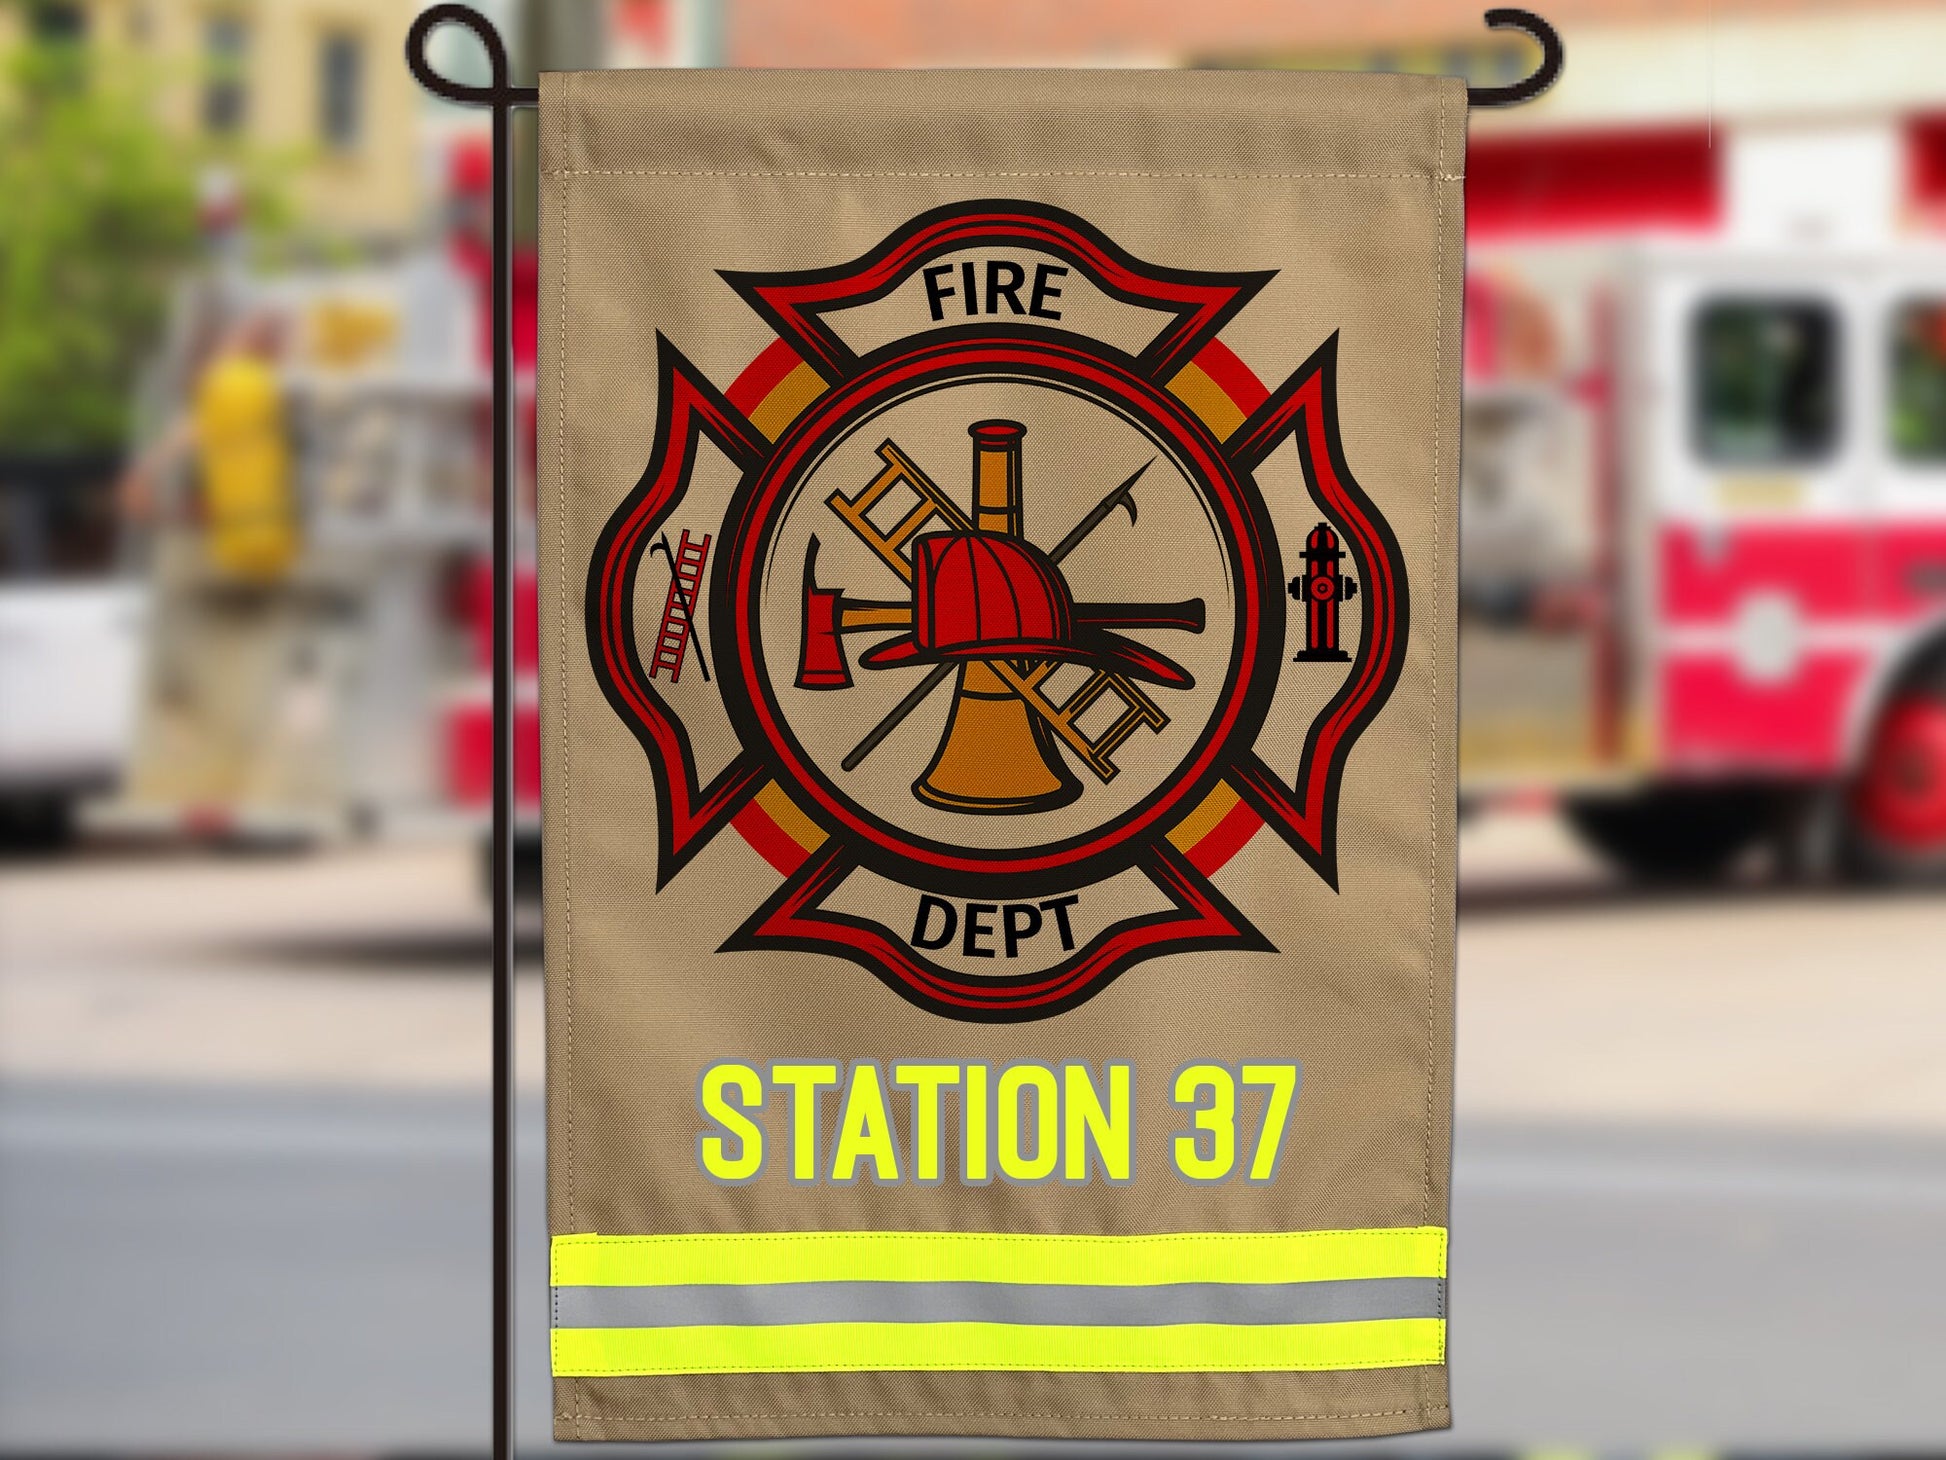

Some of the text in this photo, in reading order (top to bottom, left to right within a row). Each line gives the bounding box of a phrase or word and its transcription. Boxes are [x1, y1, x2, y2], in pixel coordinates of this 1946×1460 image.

[922, 261, 1069, 322] FIRE
[911, 893, 1080, 959] DEPT
[699, 1061, 1299, 1184] STATION 37
